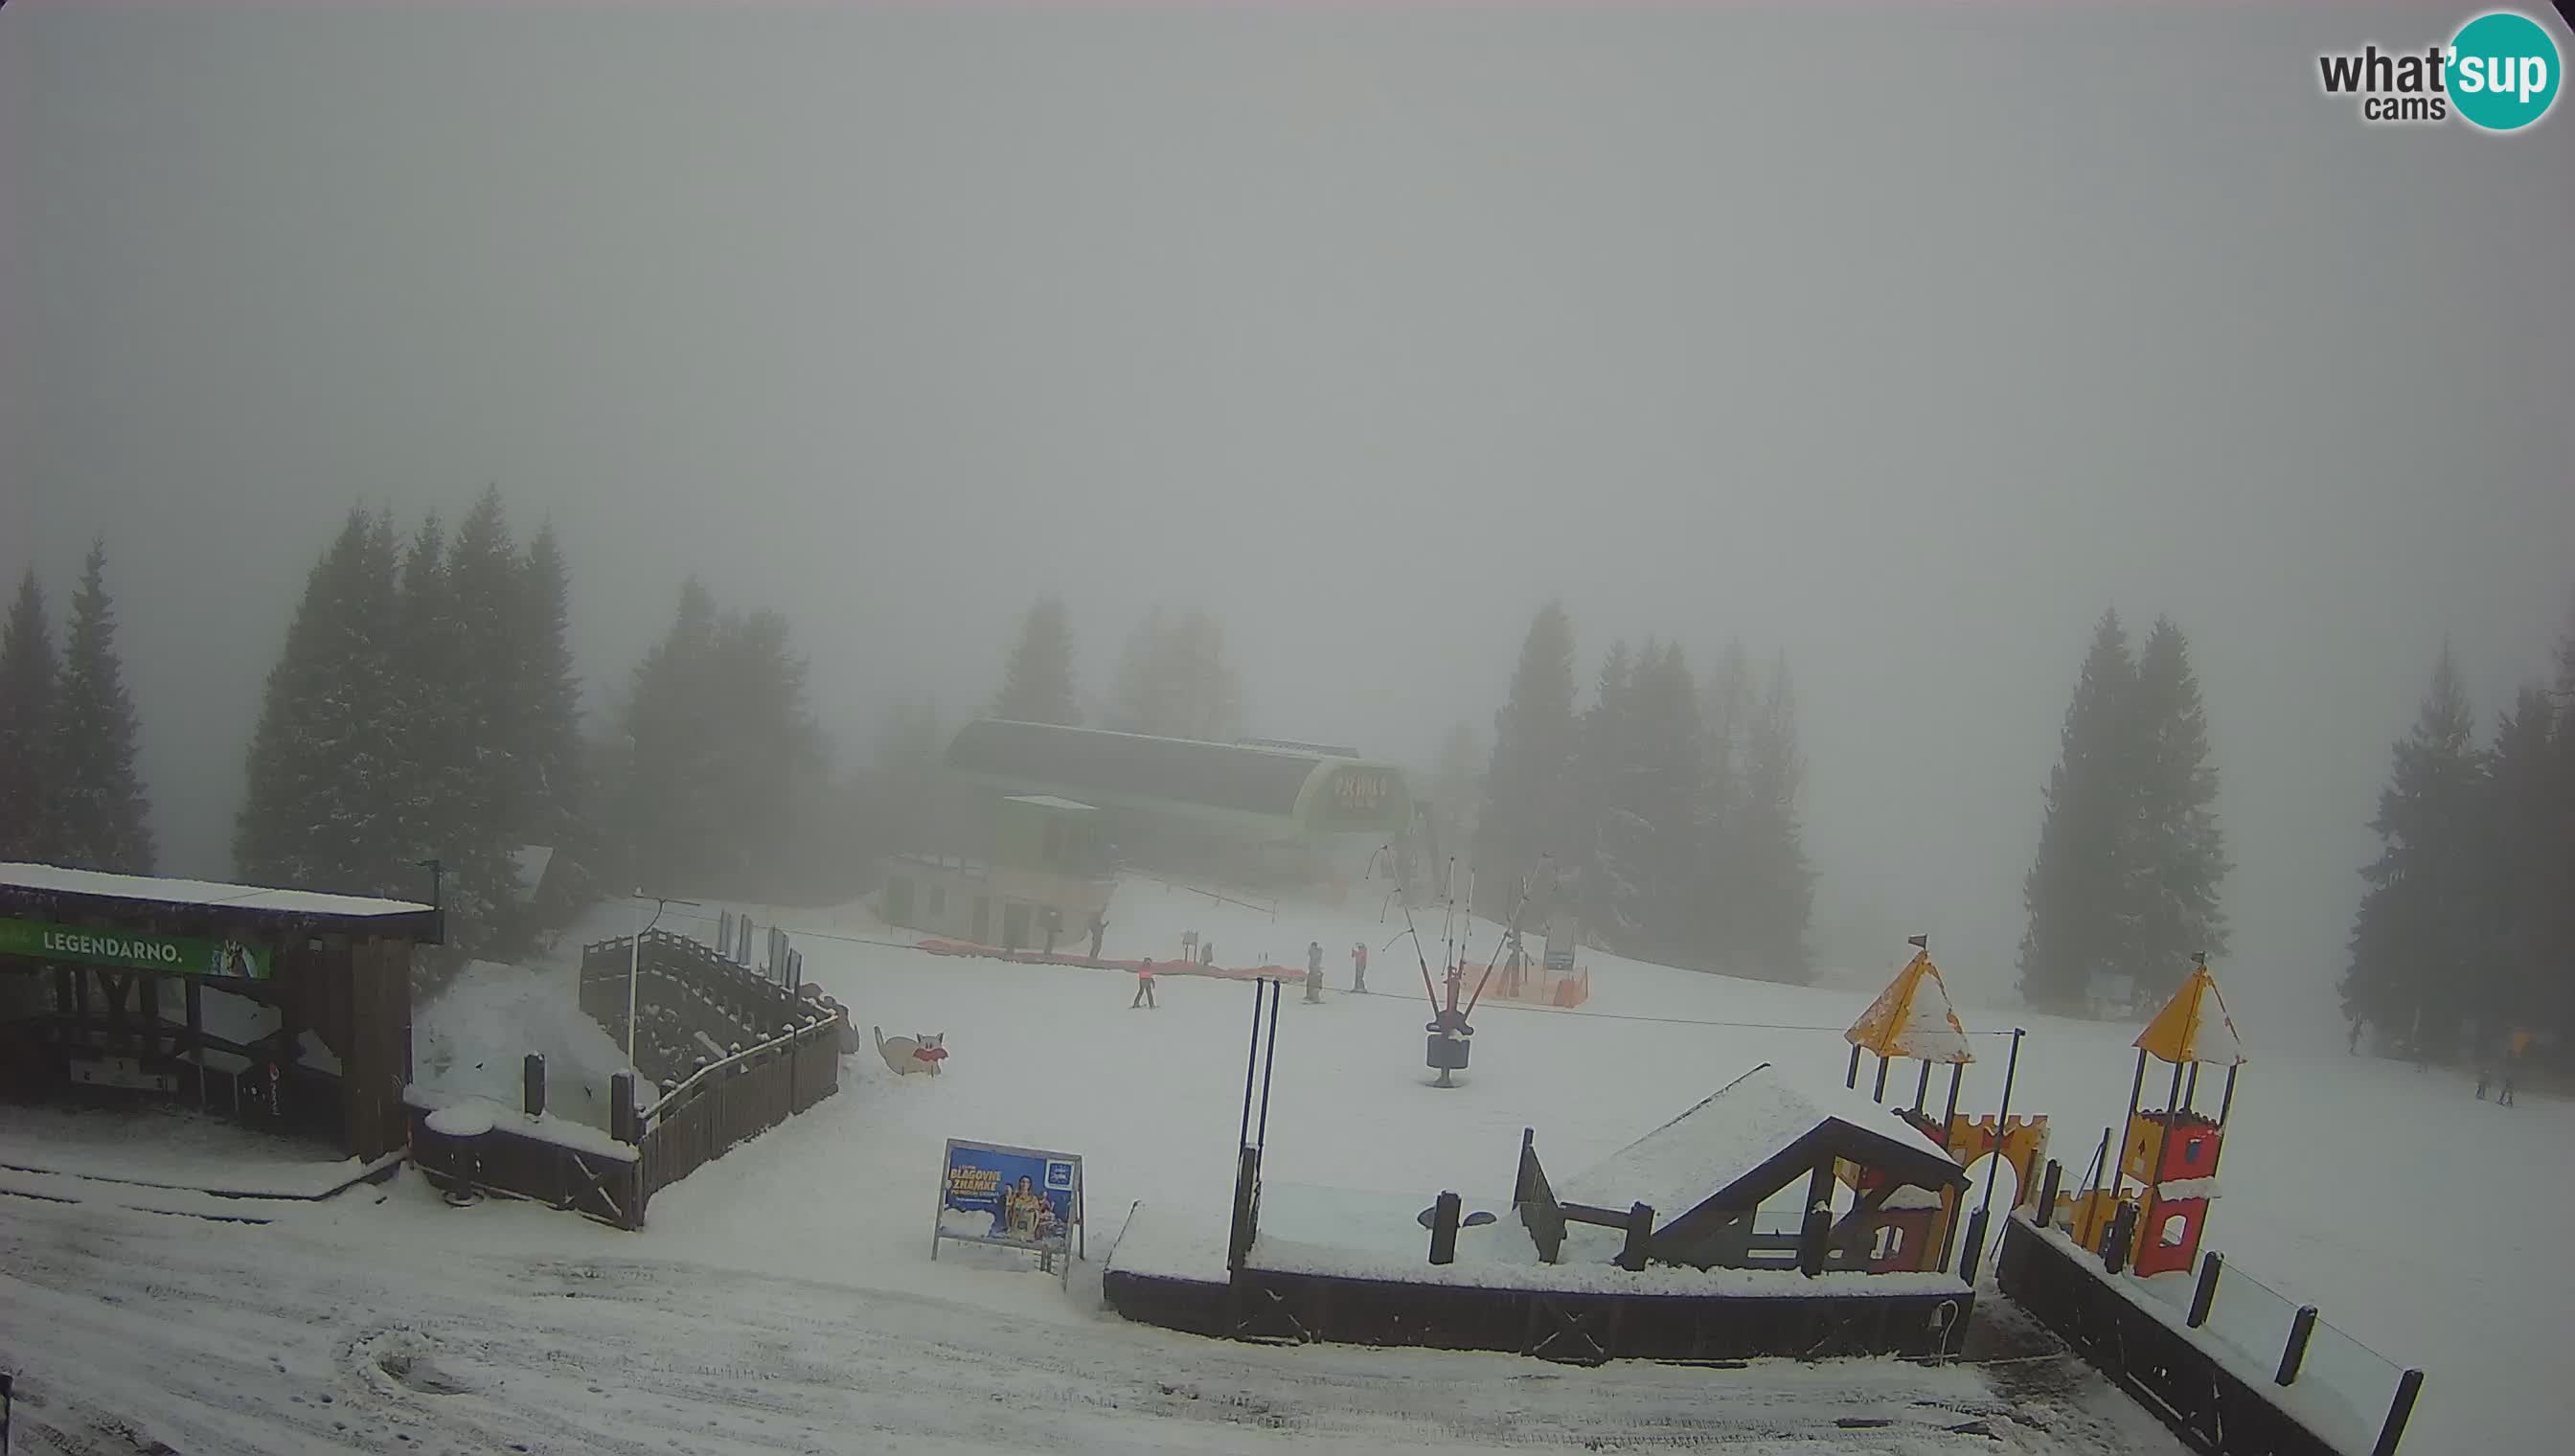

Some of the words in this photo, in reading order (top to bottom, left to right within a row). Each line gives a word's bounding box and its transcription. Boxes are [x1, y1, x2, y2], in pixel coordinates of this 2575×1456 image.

[44, 931, 182, 963] LEGENDARNO.
[950, 1168, 1002, 1181] BLAGOVNE
[952, 1179, 997, 1191] ZNAMKE
